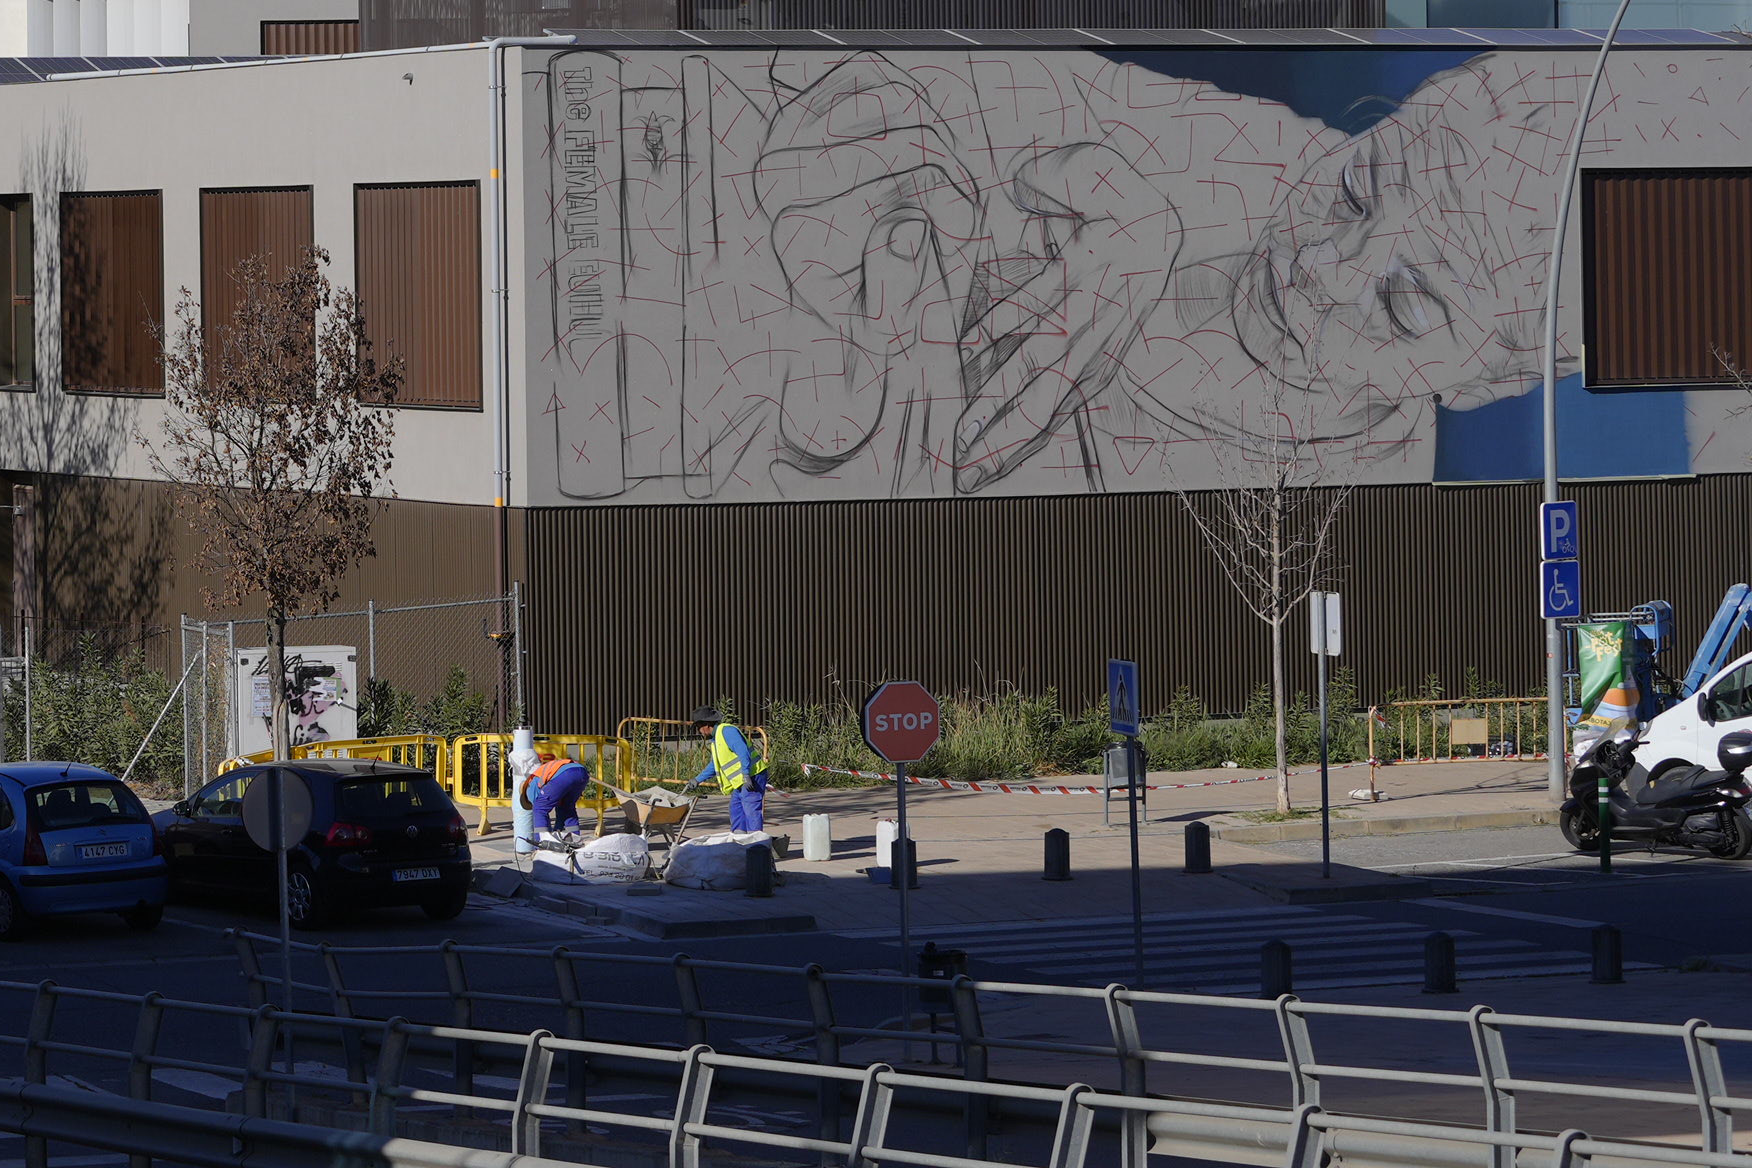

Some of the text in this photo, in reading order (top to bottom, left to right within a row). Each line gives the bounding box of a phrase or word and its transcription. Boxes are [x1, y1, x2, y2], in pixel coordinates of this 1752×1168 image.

[564, 67, 592, 122] The
[564, 129, 599, 249] FEMALE
[1549, 509, 1570, 553] P
[875, 712, 933, 732] STOP
[84, 845, 125, 857] 4147 CYG
[397, 869, 419, 880] 7947
